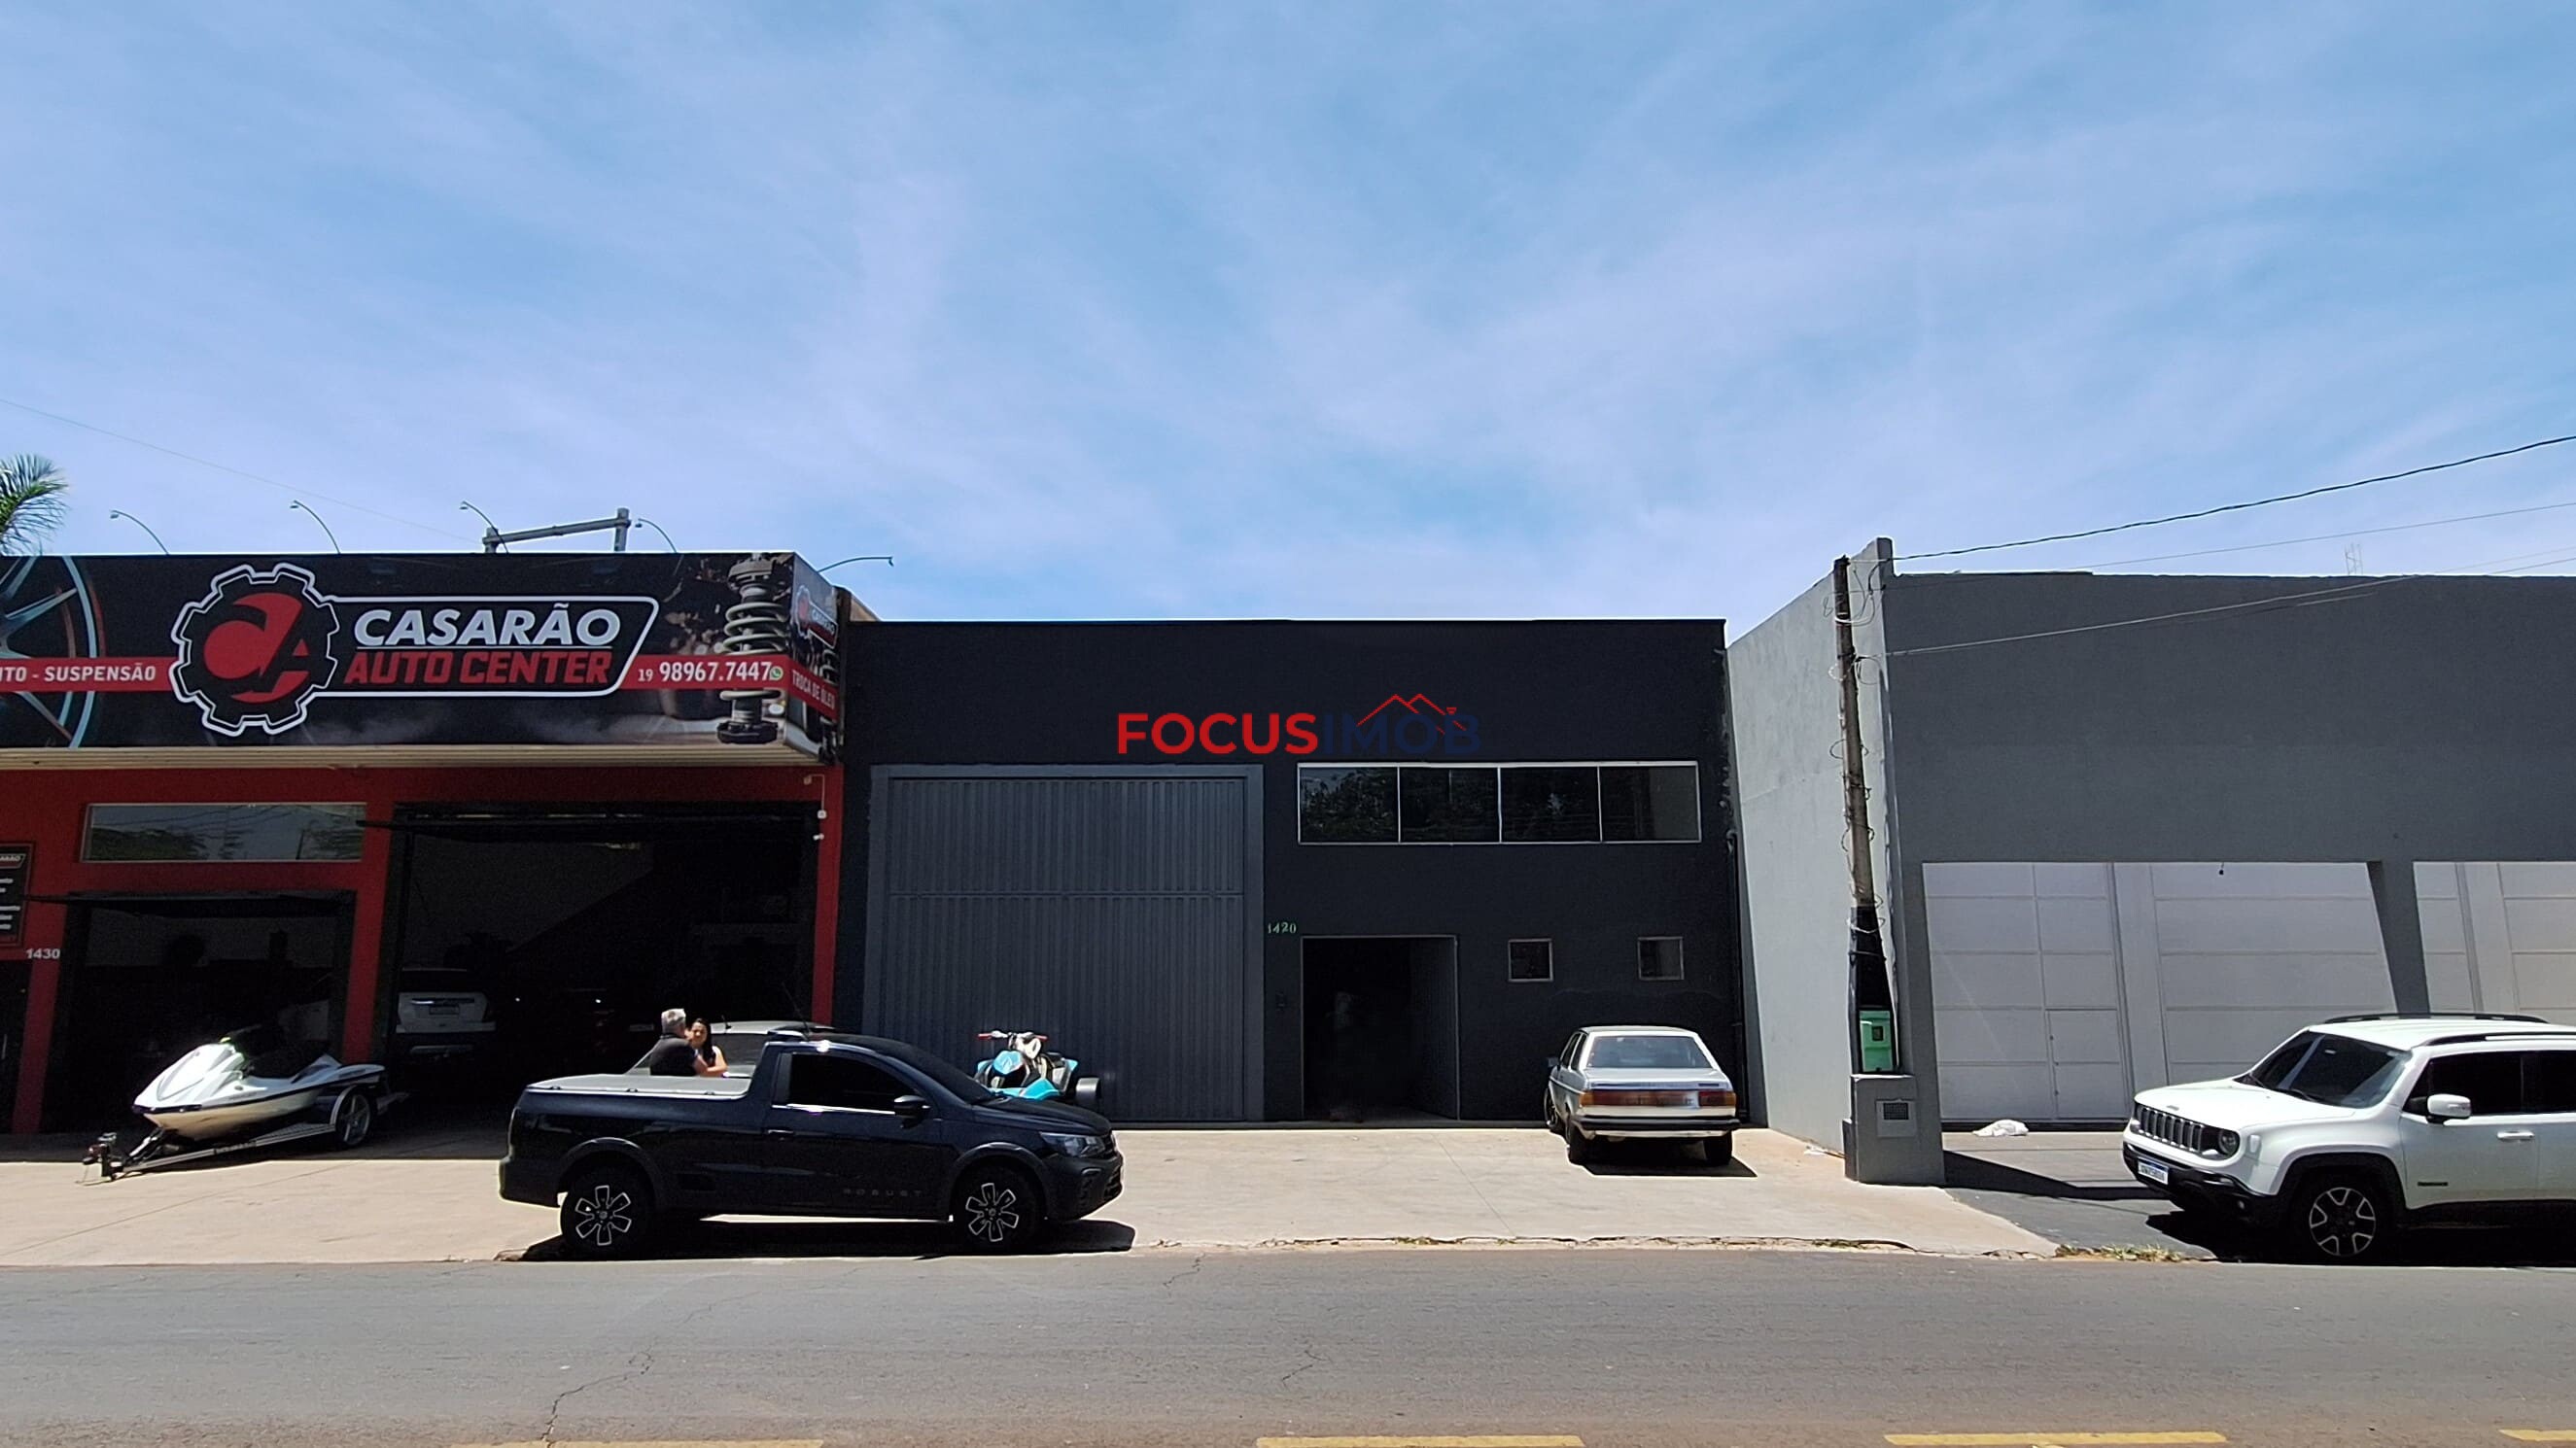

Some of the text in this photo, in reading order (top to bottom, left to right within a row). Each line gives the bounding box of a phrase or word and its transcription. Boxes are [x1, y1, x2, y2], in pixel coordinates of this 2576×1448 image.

[354, 602, 621, 647] CASARÃO
[44, 662, 157, 682] SUSPENSÃO
[343, 650, 613, 684] AUTO CENTER
[638, 661, 773, 682] 19 98967.7447
[1268, 921, 1298, 934] 1420
[26, 948, 61, 960] 1430
